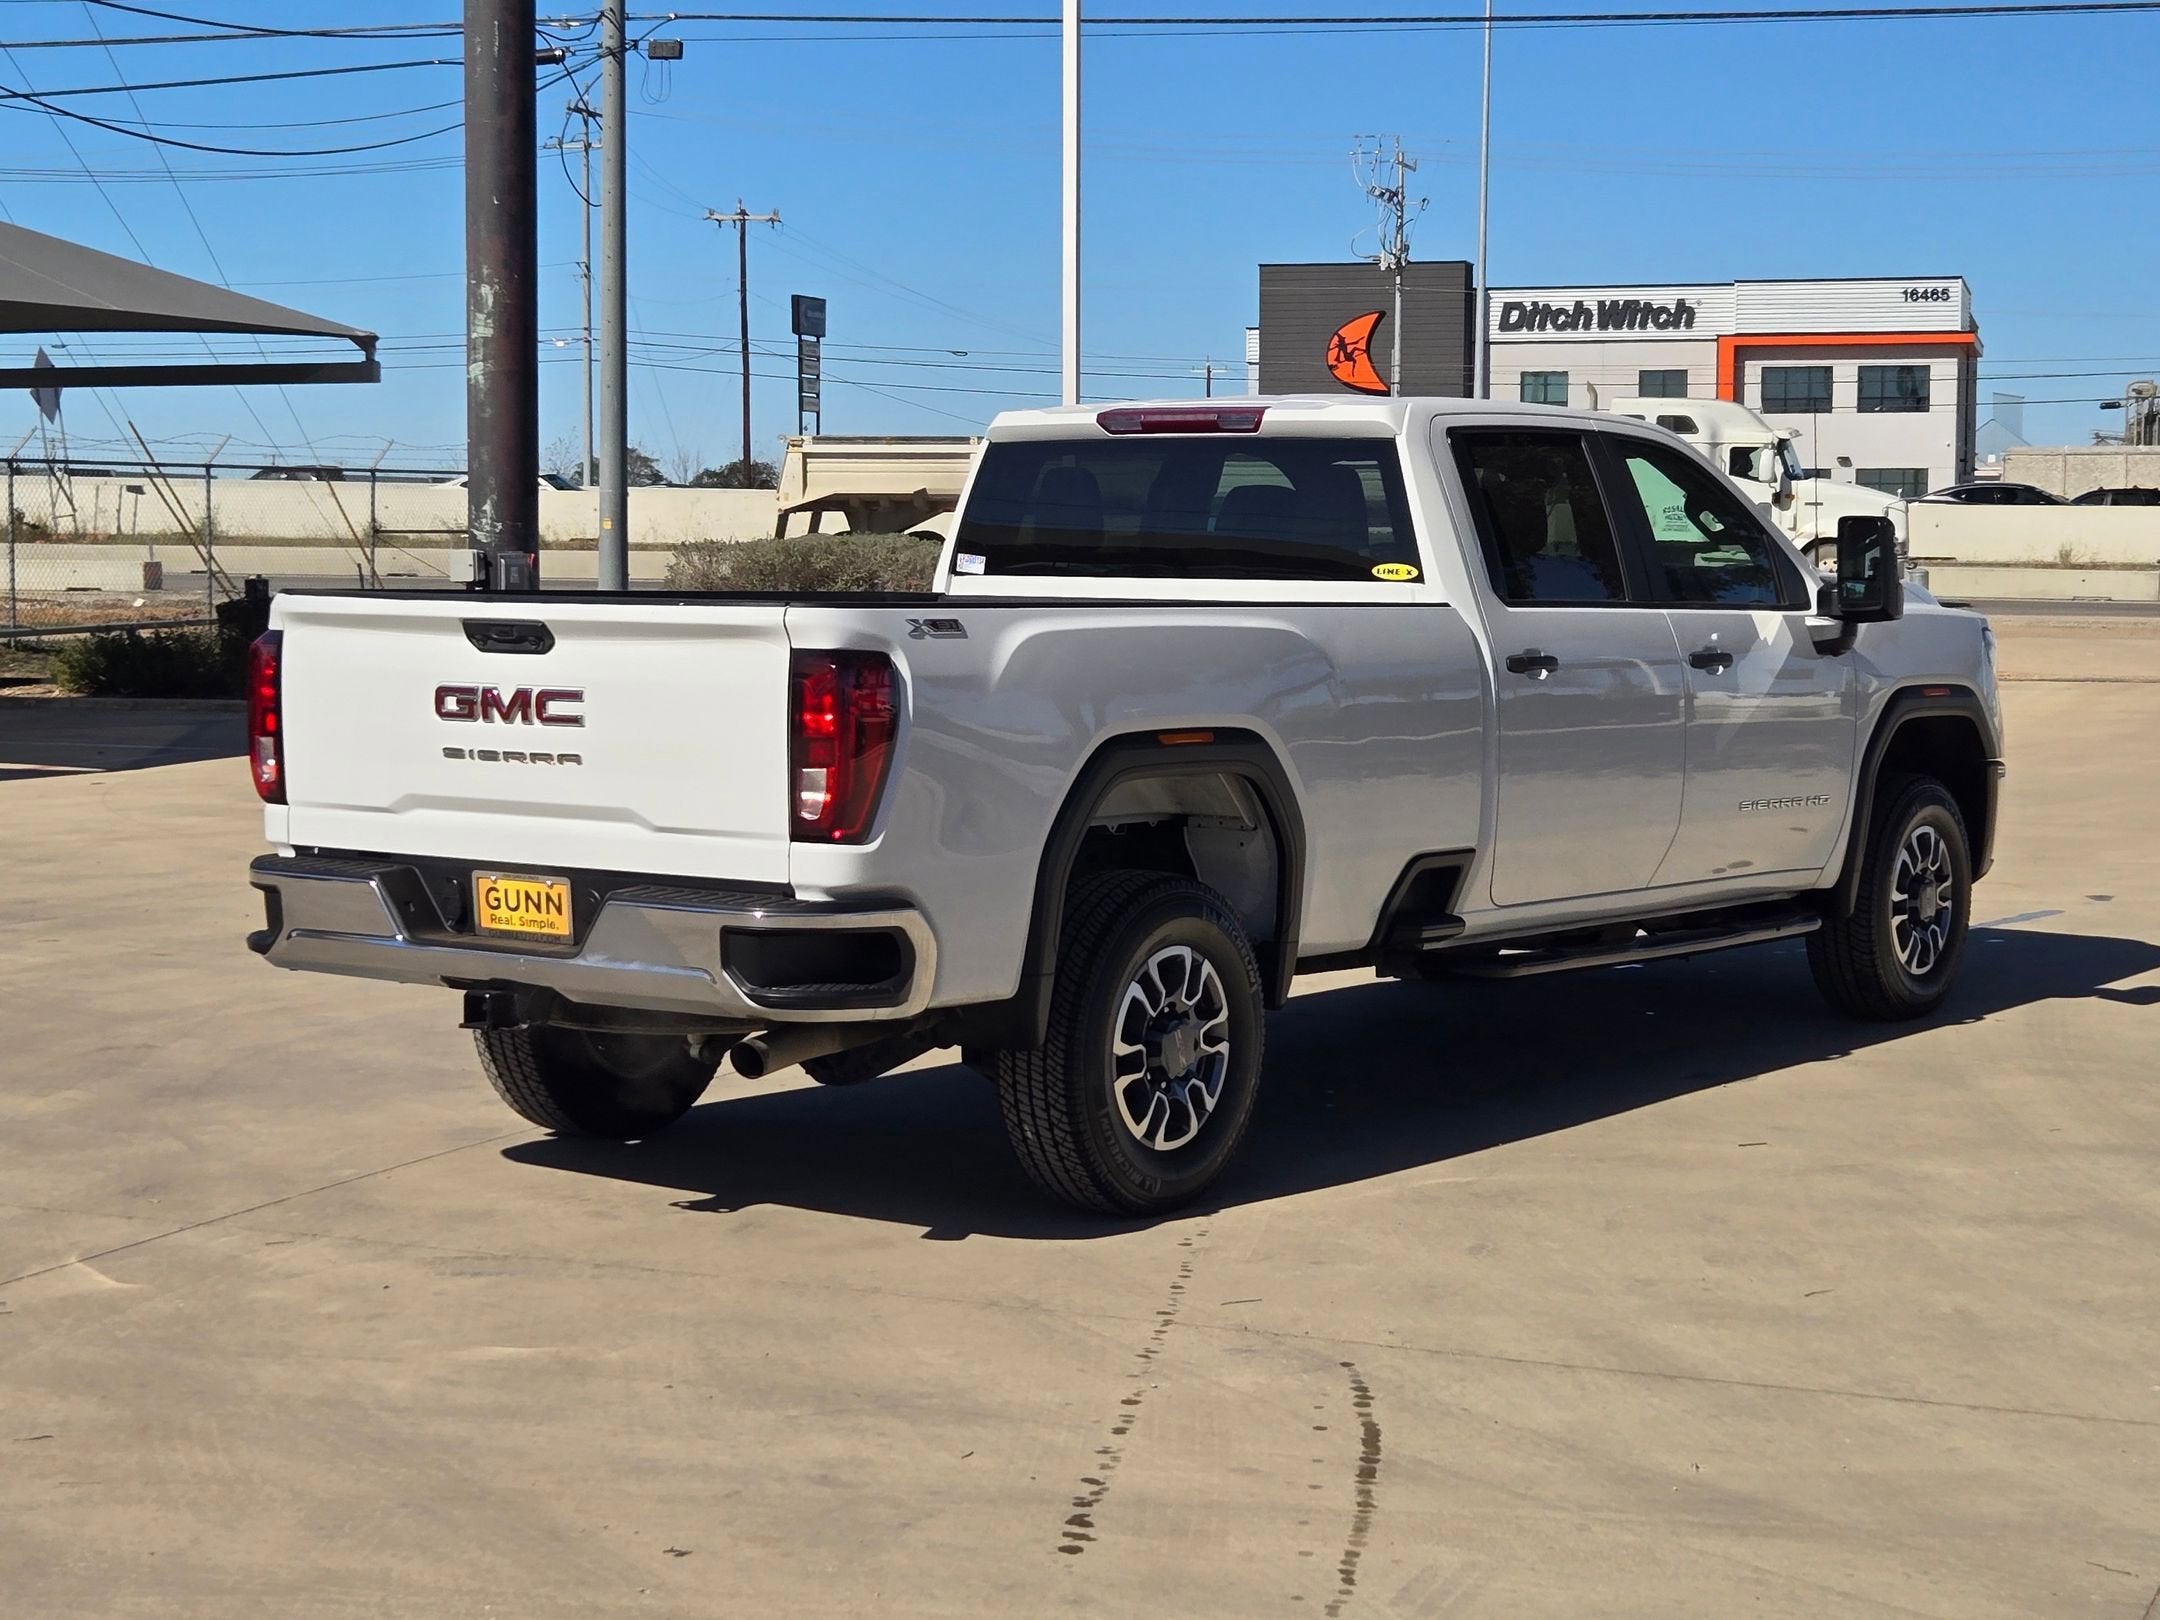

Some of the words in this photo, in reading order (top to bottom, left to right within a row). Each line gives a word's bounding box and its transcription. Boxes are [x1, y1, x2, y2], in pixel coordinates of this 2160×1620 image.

[1498, 300, 1594, 332] Ditch
[1597, 298, 1696, 331] Witch
[434, 684, 586, 728] GMC
[442, 747, 583, 766] SIERRA
[1739, 796, 1804, 811] SIERRA
[1806, 794, 1831, 806] HD
[485, 886, 563, 916] GUNN
[490, 913, 517, 927] Real.
[519, 916, 560, 931] Simple.
